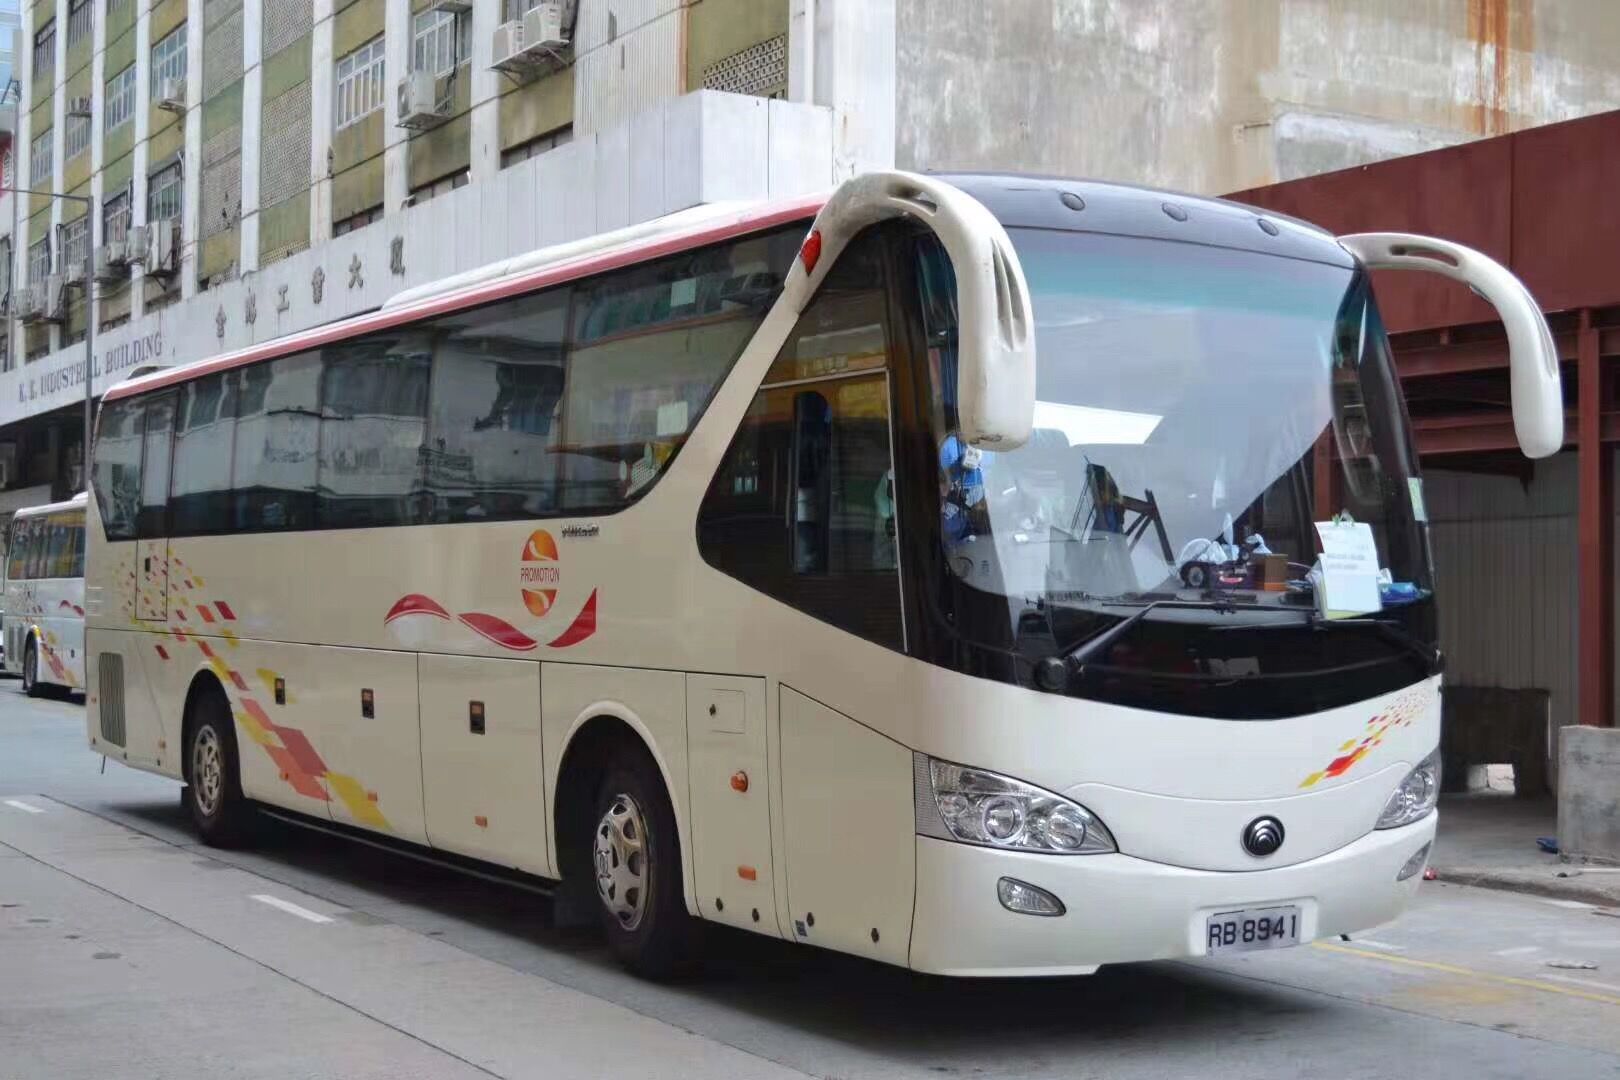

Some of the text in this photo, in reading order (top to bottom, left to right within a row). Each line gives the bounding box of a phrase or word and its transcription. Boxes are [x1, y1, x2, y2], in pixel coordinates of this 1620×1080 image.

[40, 355, 101, 396] INDUSTRIL
[105, 332, 162, 375] BUILDING
[520, 568, 560, 583] PROMOTION
[1208, 915, 1297, 948] RB 8941
